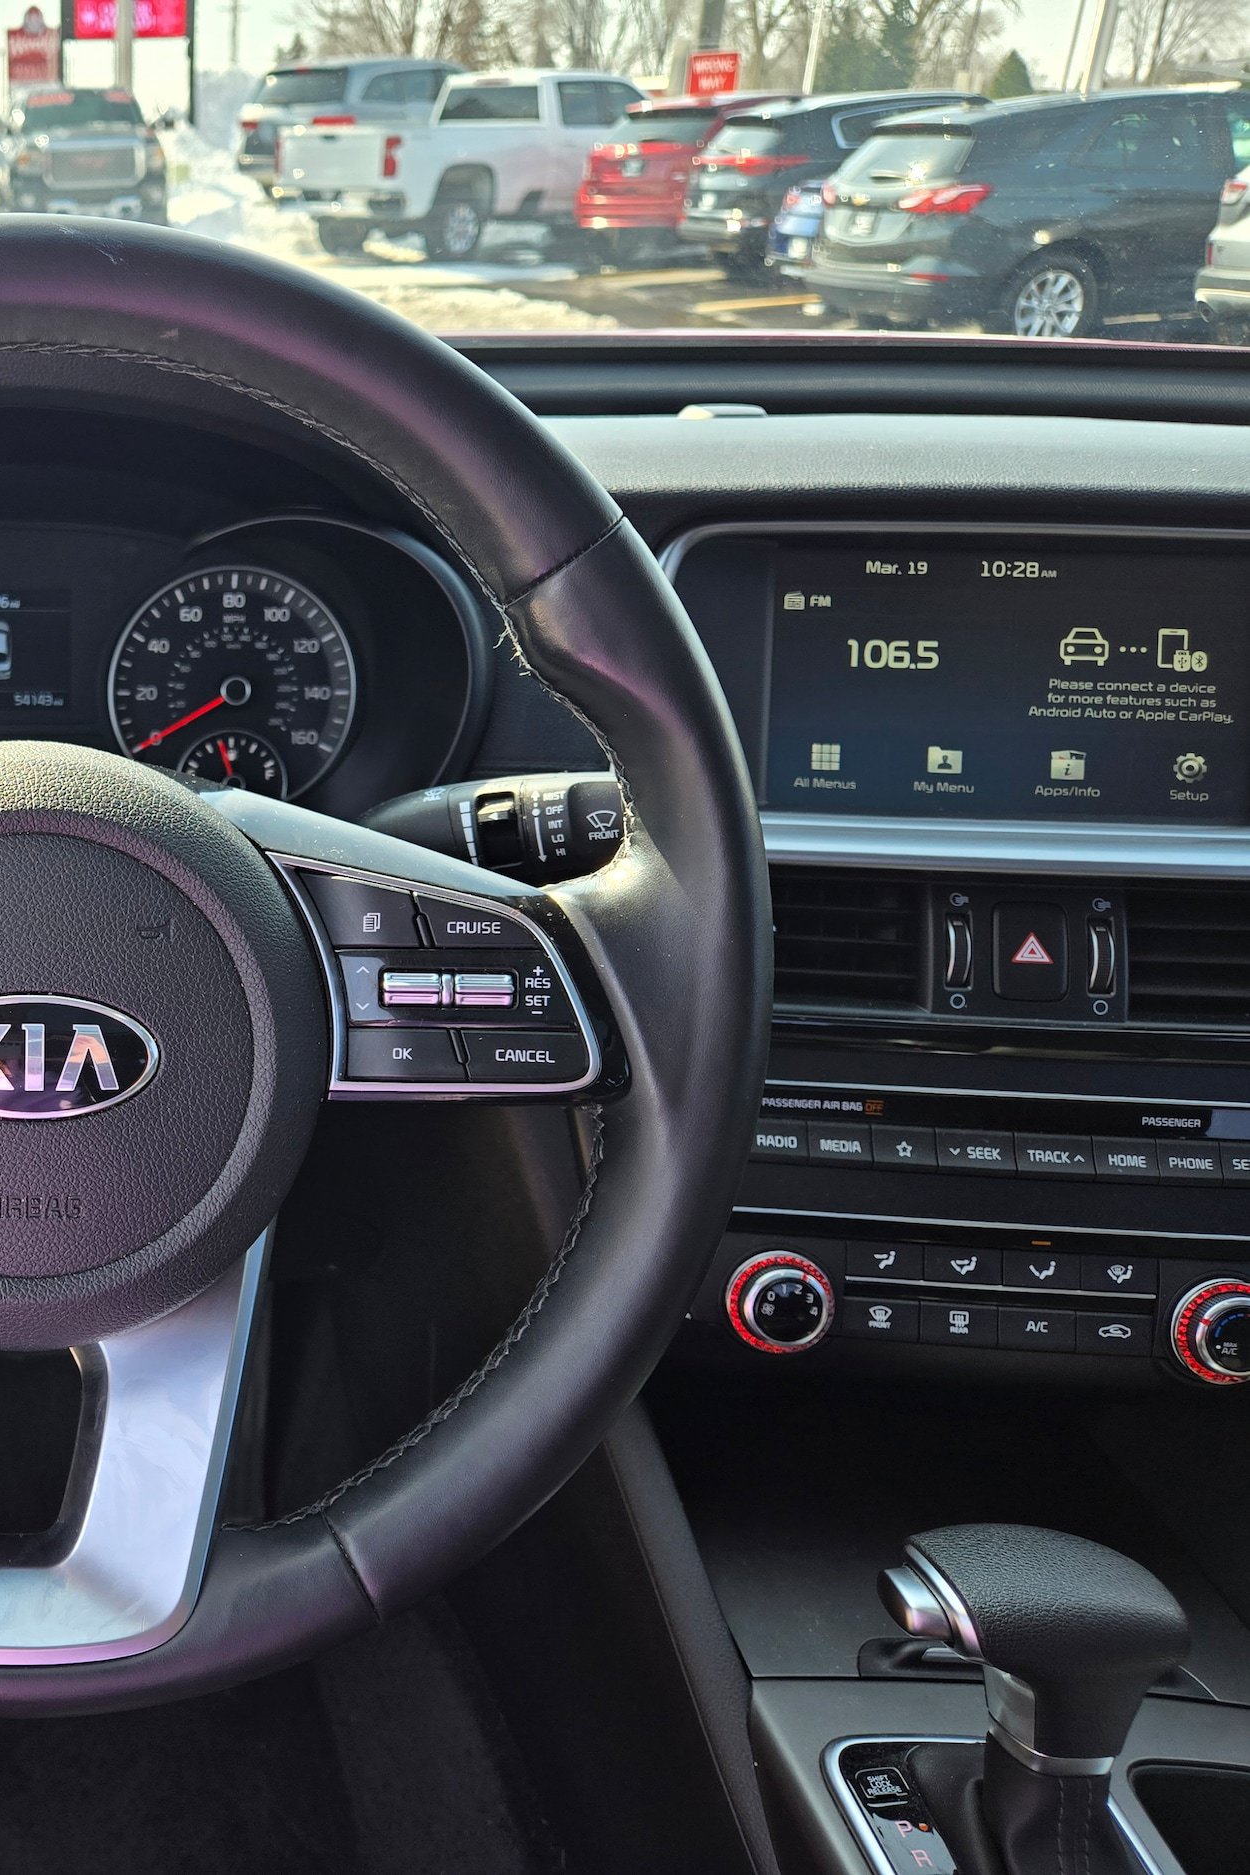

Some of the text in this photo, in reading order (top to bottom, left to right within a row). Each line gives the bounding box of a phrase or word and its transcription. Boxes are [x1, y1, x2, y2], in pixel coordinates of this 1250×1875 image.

[865, 560, 928, 575] Mar. 19
[222, 592, 246, 608] 80
[809, 594, 832, 608] FM
[179, 607, 202, 622] 60
[263, 607, 290, 622] 100
[147, 639, 170, 654] 40
[293, 639, 319, 654] 120
[847, 639, 940, 670] 106.5
[135, 685, 158, 701] 20
[1049, 678, 1216, 694] Please connect a device
[304, 686, 331, 701] 140
[1048, 693, 1216, 708] for more features such as
[1028, 706, 1235, 724] Android Auto or Apple CarPlay.
[291, 731, 318, 746] 160
[265, 767, 275, 780] F
[793, 777, 857, 790] All Menus
[913, 781, 975, 794] My Menu
[1034, 785, 1101, 798] Apps/Info
[1169, 789, 1209, 802] Setup
[545, 804, 564, 815] OFF
[547, 819, 563, 830] INT
[551, 834, 565, 843] LO
[588, 829, 620, 840] FRONT
[555, 848, 566, 856] HI
[446, 921, 502, 935] CRUISE
[525, 977, 551, 989] RES
[525, 995, 550, 1007] SET
[392, 1047, 413, 1061] OK
[494, 1049, 556, 1064] CANCEL
[761, 1097, 884, 1113] PASSENGER AIR BAG OFF
[1141, 1116, 1201, 1128] PASSENGER
[756, 1134, 798, 1149] RADIO
[819, 1138, 862, 1153] MEDIA
[966, 1146, 1001, 1161] SEEK
[1026, 1149, 1071, 1164] TRACK
[1108, 1154, 1147, 1168] HOME
[1168, 1156, 1214, 1170] PHONE
[794, 1284, 803, 1295] 2
[806, 1292, 814, 1304] 3
[809, 1306, 819, 1316] 4
[949, 1326, 969, 1334] REAR
[1025, 1320, 1049, 1333] A/C
[1221, 1347, 1238, 1355] A/C
[866, 1774, 889, 1782] SHIFT
[870, 1780, 893, 1789] LOCK
[867, 1785, 903, 1795] RELEASE
[894, 1820, 913, 1838] P
[910, 1849, 934, 1868] R
